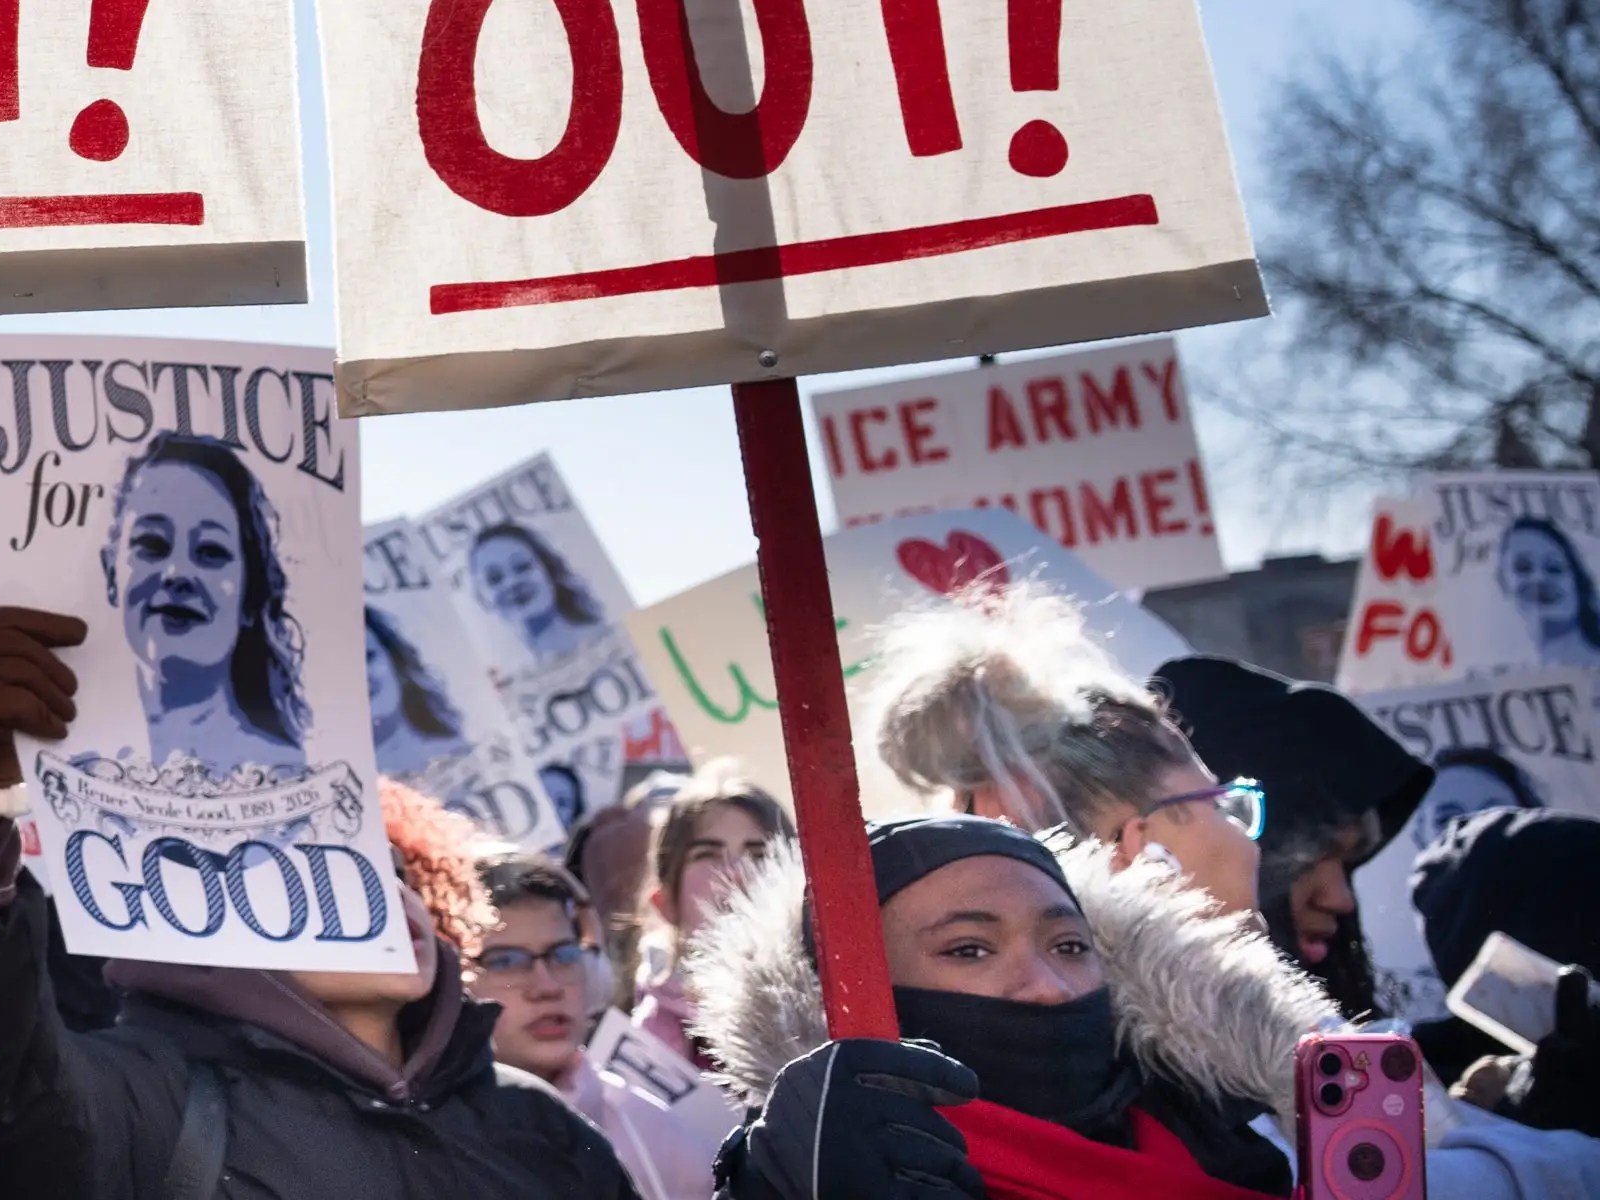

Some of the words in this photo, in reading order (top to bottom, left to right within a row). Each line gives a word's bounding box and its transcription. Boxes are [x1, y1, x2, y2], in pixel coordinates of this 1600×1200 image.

[821, 397, 951, 481] ICE
[986, 356, 1181, 453] ARMY
[11, 451, 104, 552] for
[972, 458, 1216, 549] OME!
[66, 829, 388, 943] GOOD
